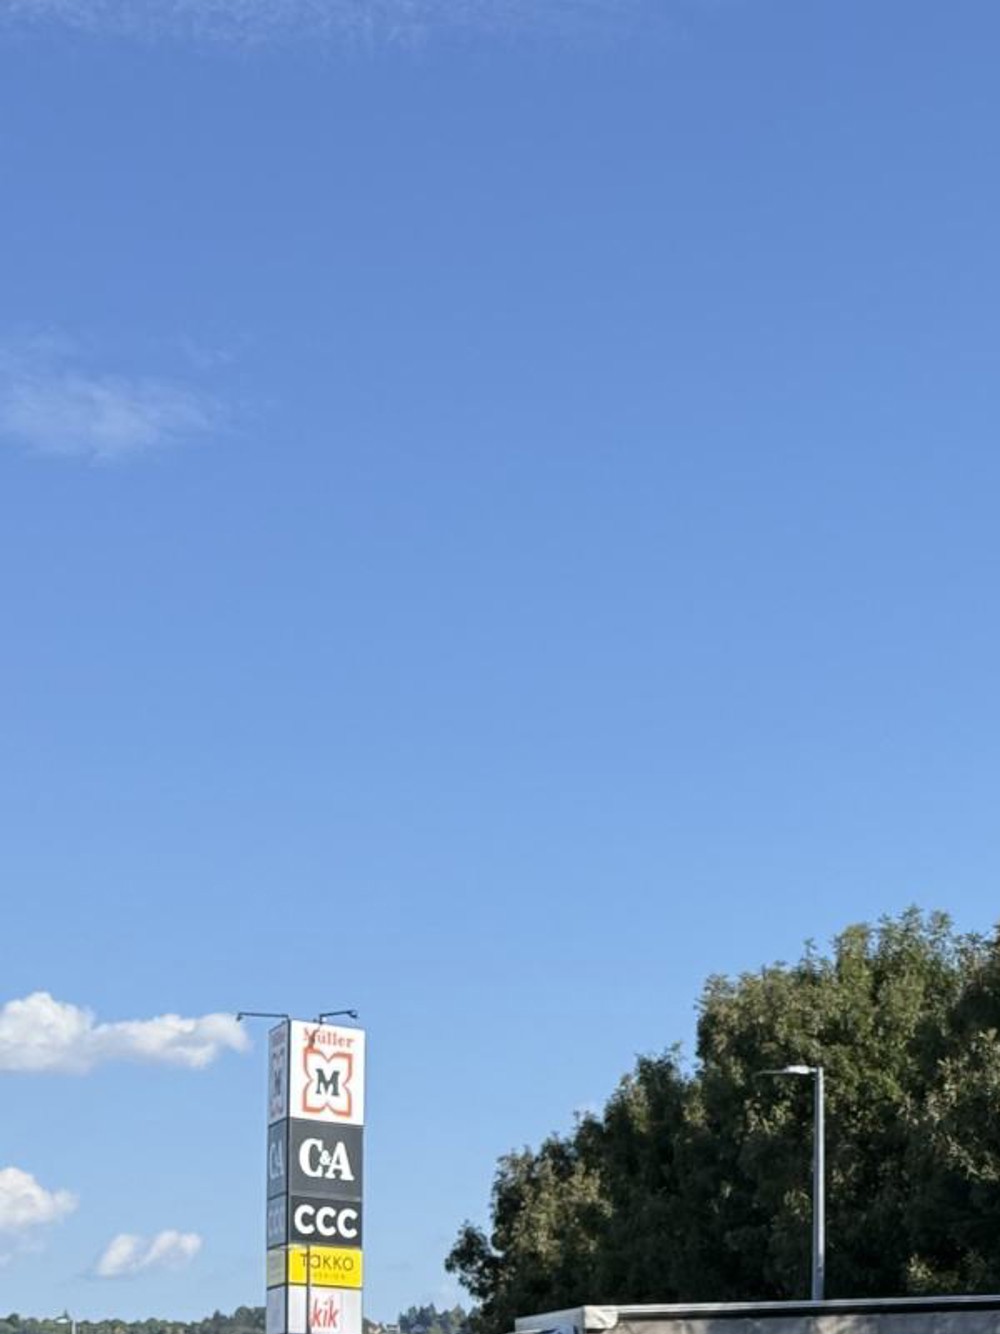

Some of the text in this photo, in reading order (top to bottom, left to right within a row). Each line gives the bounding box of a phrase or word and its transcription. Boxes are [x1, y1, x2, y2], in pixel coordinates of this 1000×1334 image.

[316, 1069, 340, 1096] M
[299, 1138, 354, 1181] C&A
[294, 1204, 358, 1238] CCC
